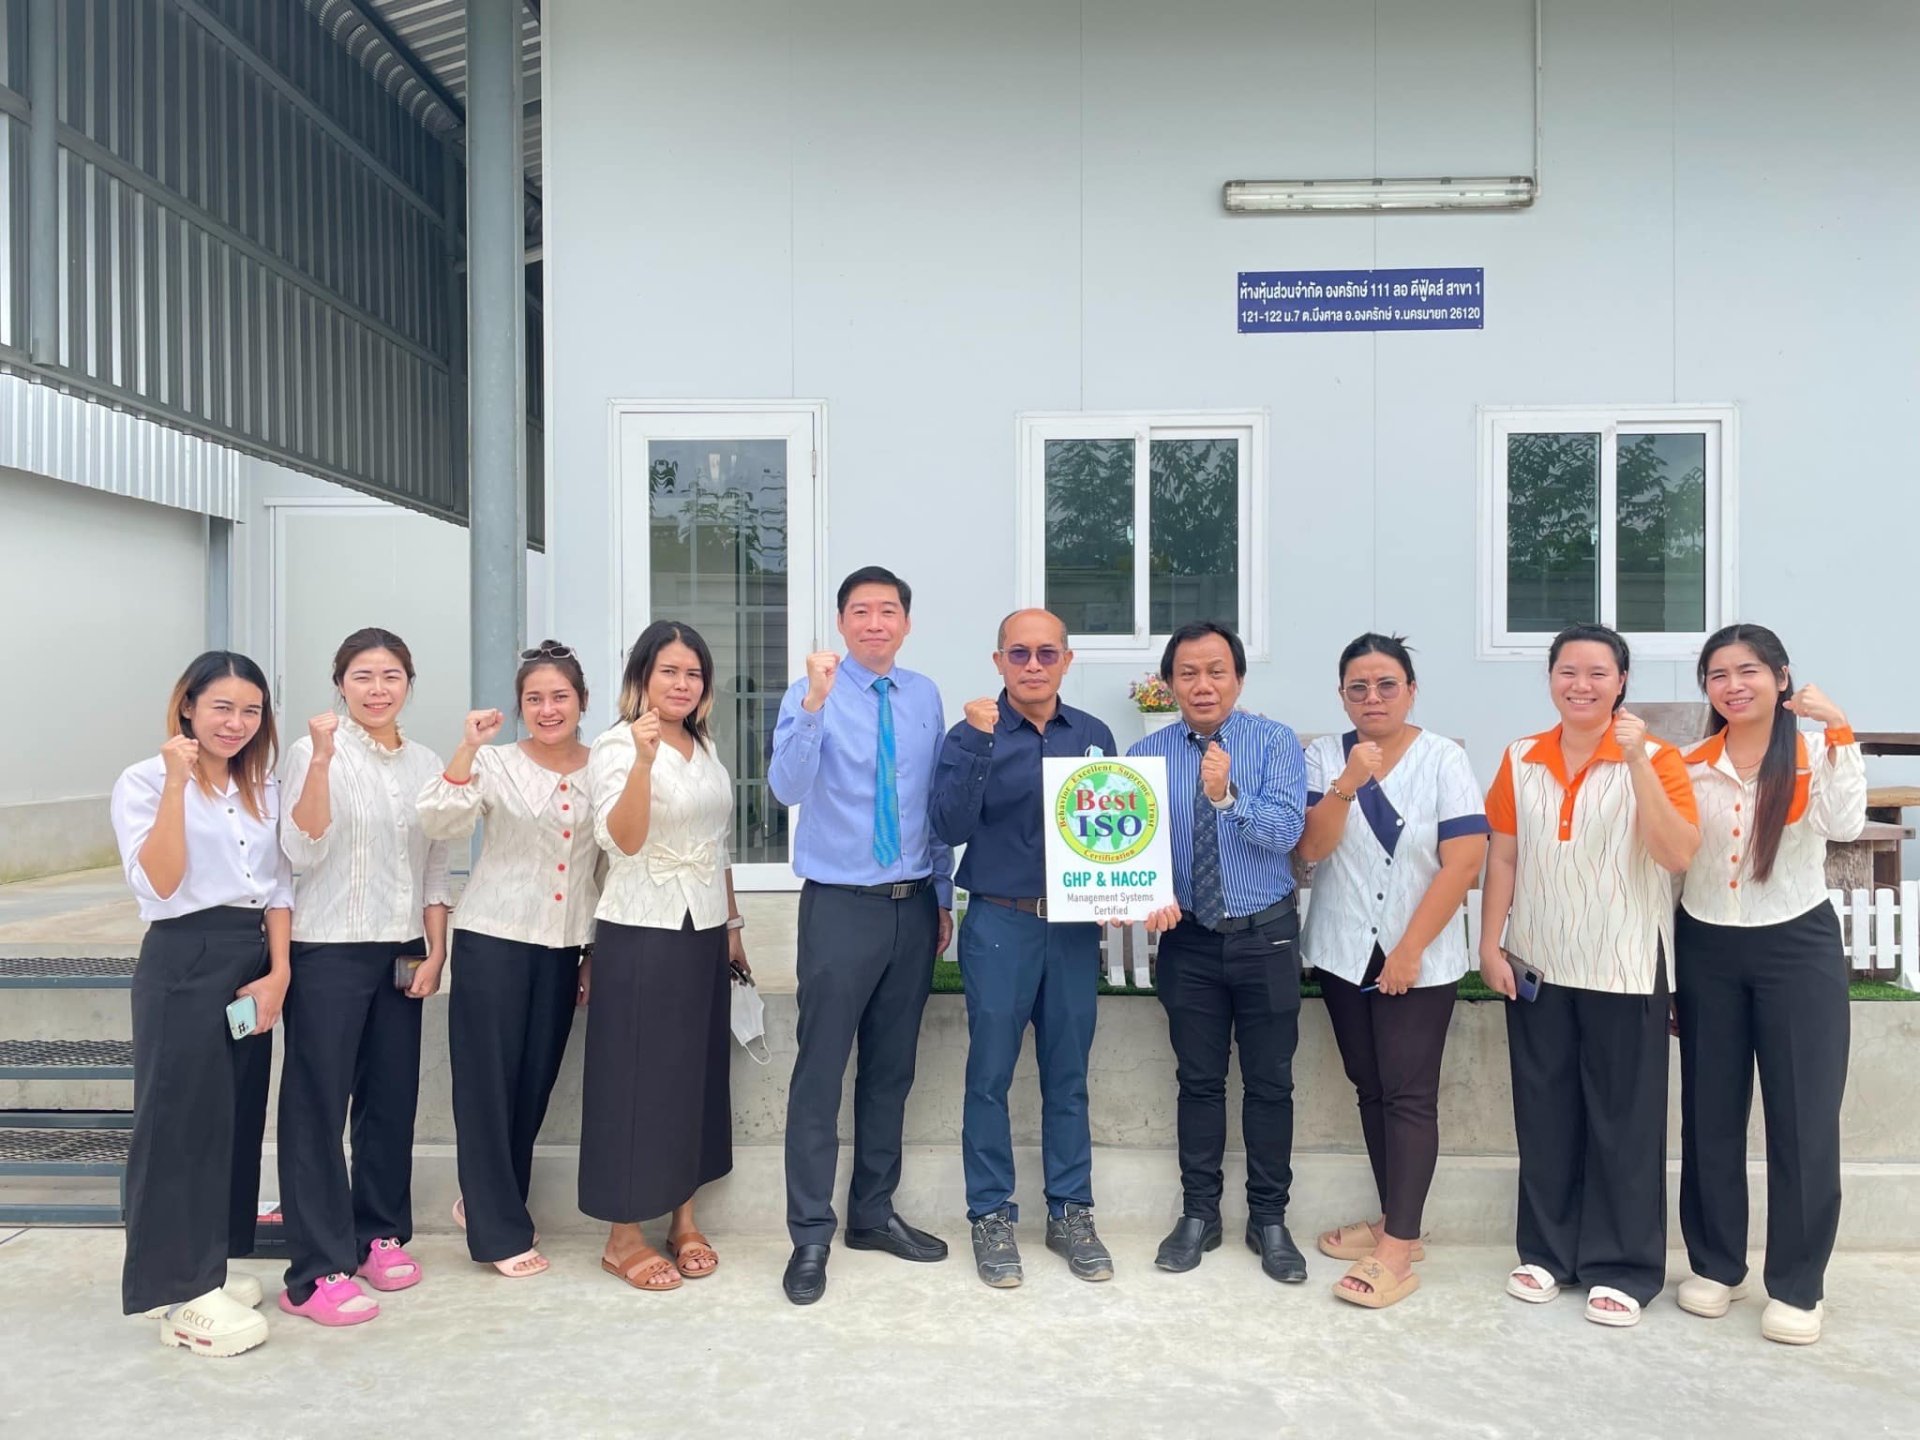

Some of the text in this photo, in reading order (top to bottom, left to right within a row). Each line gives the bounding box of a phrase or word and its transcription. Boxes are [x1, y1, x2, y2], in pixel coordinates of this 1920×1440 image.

[1325, 280, 1368, 298] องครักษ์
[1371, 283, 1390, 297] 111
[1393, 284, 1408, 297] ลอ
[1446, 282, 1472, 296] สาขา
[1475, 282, 1480, 295] 1
[1241, 310, 1282, 323] 121-122
[1394, 309, 1448, 320] จ.นครนายก
[1450, 307, 1480, 319] 26120
[1058, 765, 1156, 828] Behavior Excellent Supreme Trust
[1075, 789, 1137, 811] Best
[1077, 814, 1143, 837] ISO
[1083, 849, 1135, 862] Certification
[1063, 870, 1157, 887] GHP & HACCP
[1067, 892, 1154, 904] Management Systems
[1094, 906, 1129, 915] Certified
[182, 1308, 215, 1331] GUCCI
